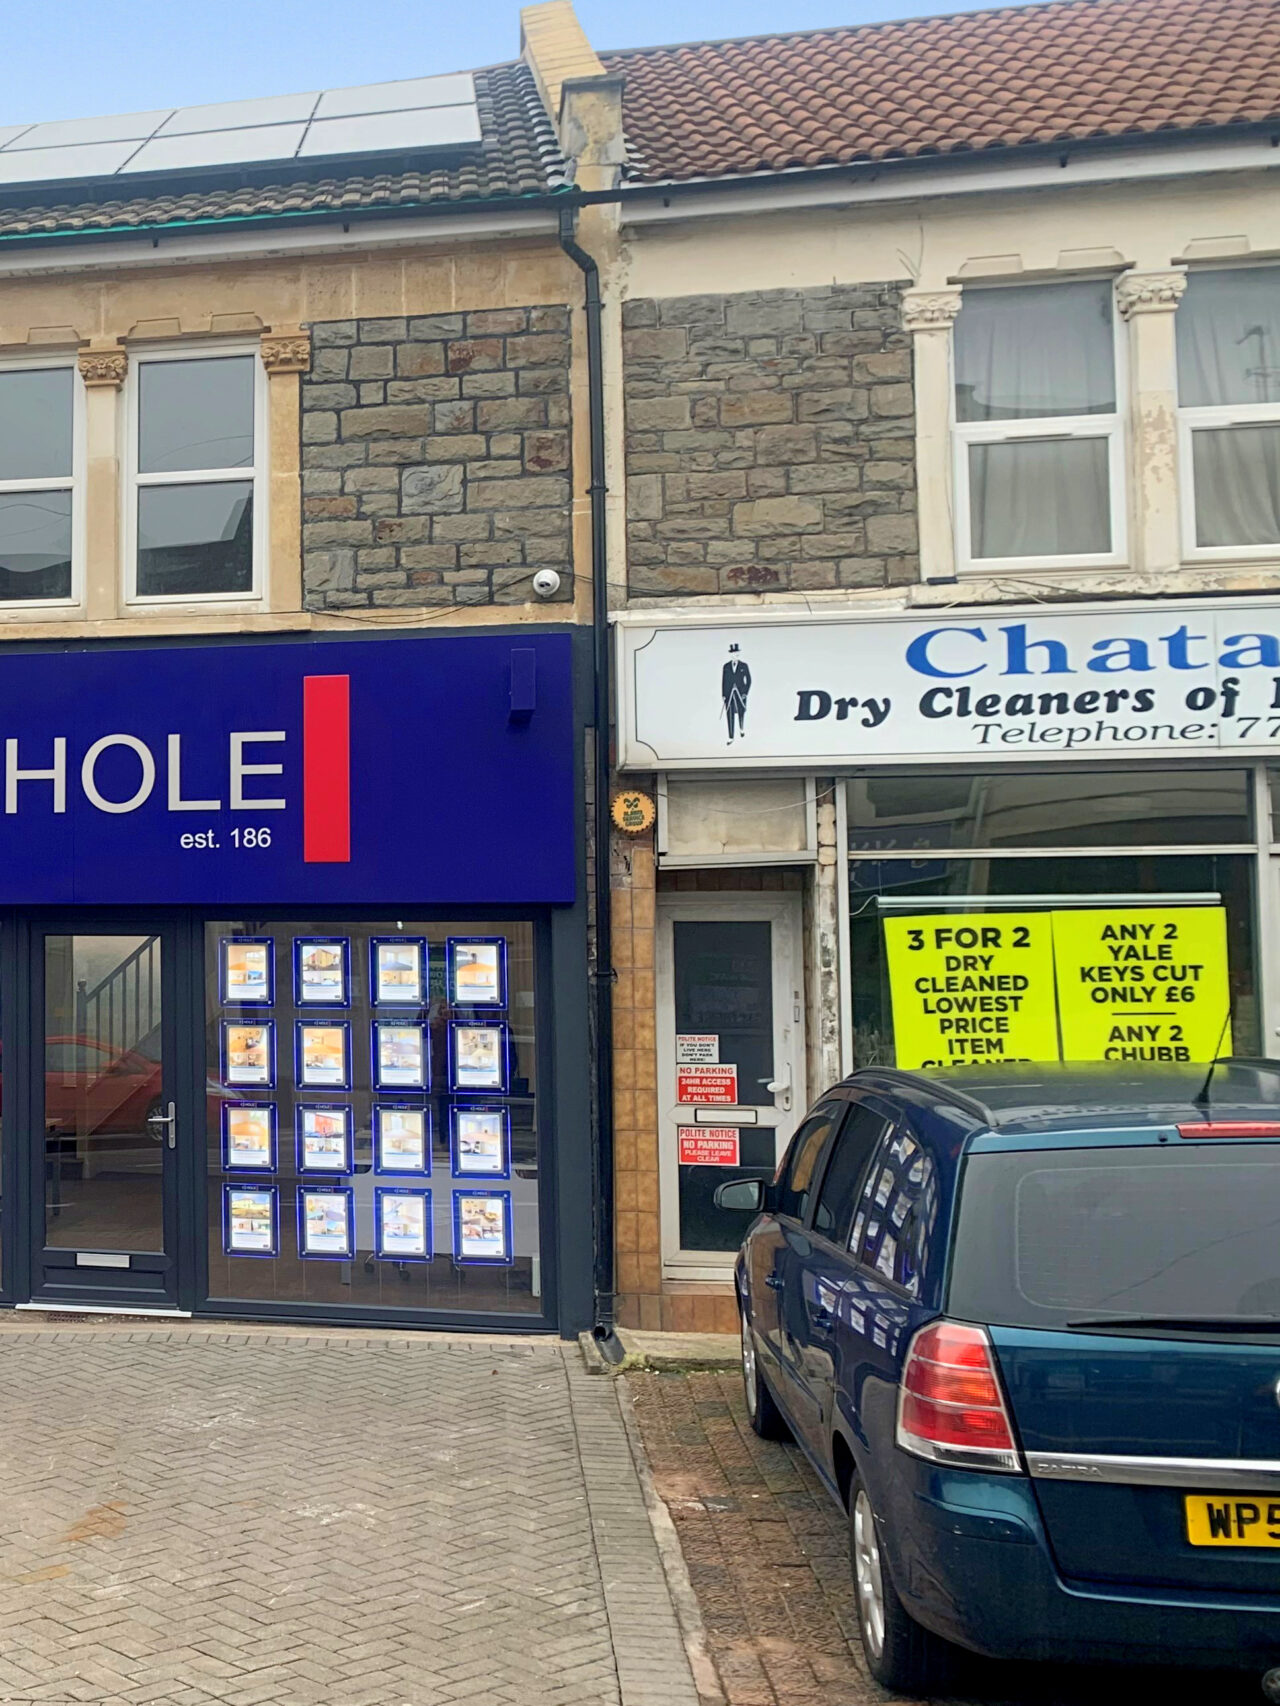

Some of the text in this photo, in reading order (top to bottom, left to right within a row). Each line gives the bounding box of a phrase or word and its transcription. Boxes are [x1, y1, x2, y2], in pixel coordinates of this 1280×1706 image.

[793, 689, 892, 728] Dry
[919, 686, 1156, 720] Cleaners
[1184, 676, 1240, 718] of
[970, 718, 1218, 749] Telephone:
[5, 730, 287, 814] HOLE
[179, 827, 272, 849] est. 186
[907, 926, 1031, 951] 3 FOR 2
[1101, 923, 1178, 941] ANY 2
[1107, 944, 1173, 962] YALE
[945, 955, 995, 972] DRY
[1080, 964, 1204, 983] KEYS CUT
[914, 975, 1029, 994] CLEANED
[1091, 985, 1196, 1004] ONLY £6
[922, 996, 1023, 1014] LOWEST
[939, 1017, 1010, 1034] PRICE
[1108, 1025, 1184, 1043] ANY 2
[948, 1037, 1004, 1055] ITEM
[1104, 1046, 1191, 1062] CHUBB
[695, 1067, 734, 1075] PARKING
[682, 1094, 691, 1102] AT
[692, 1094, 707, 1102] ALL
[687, 1086, 725, 1094] REQUIRED
[680, 1129, 737, 1138] POLITE NOTICE
[683, 1140, 734, 1150] NO PARKING
